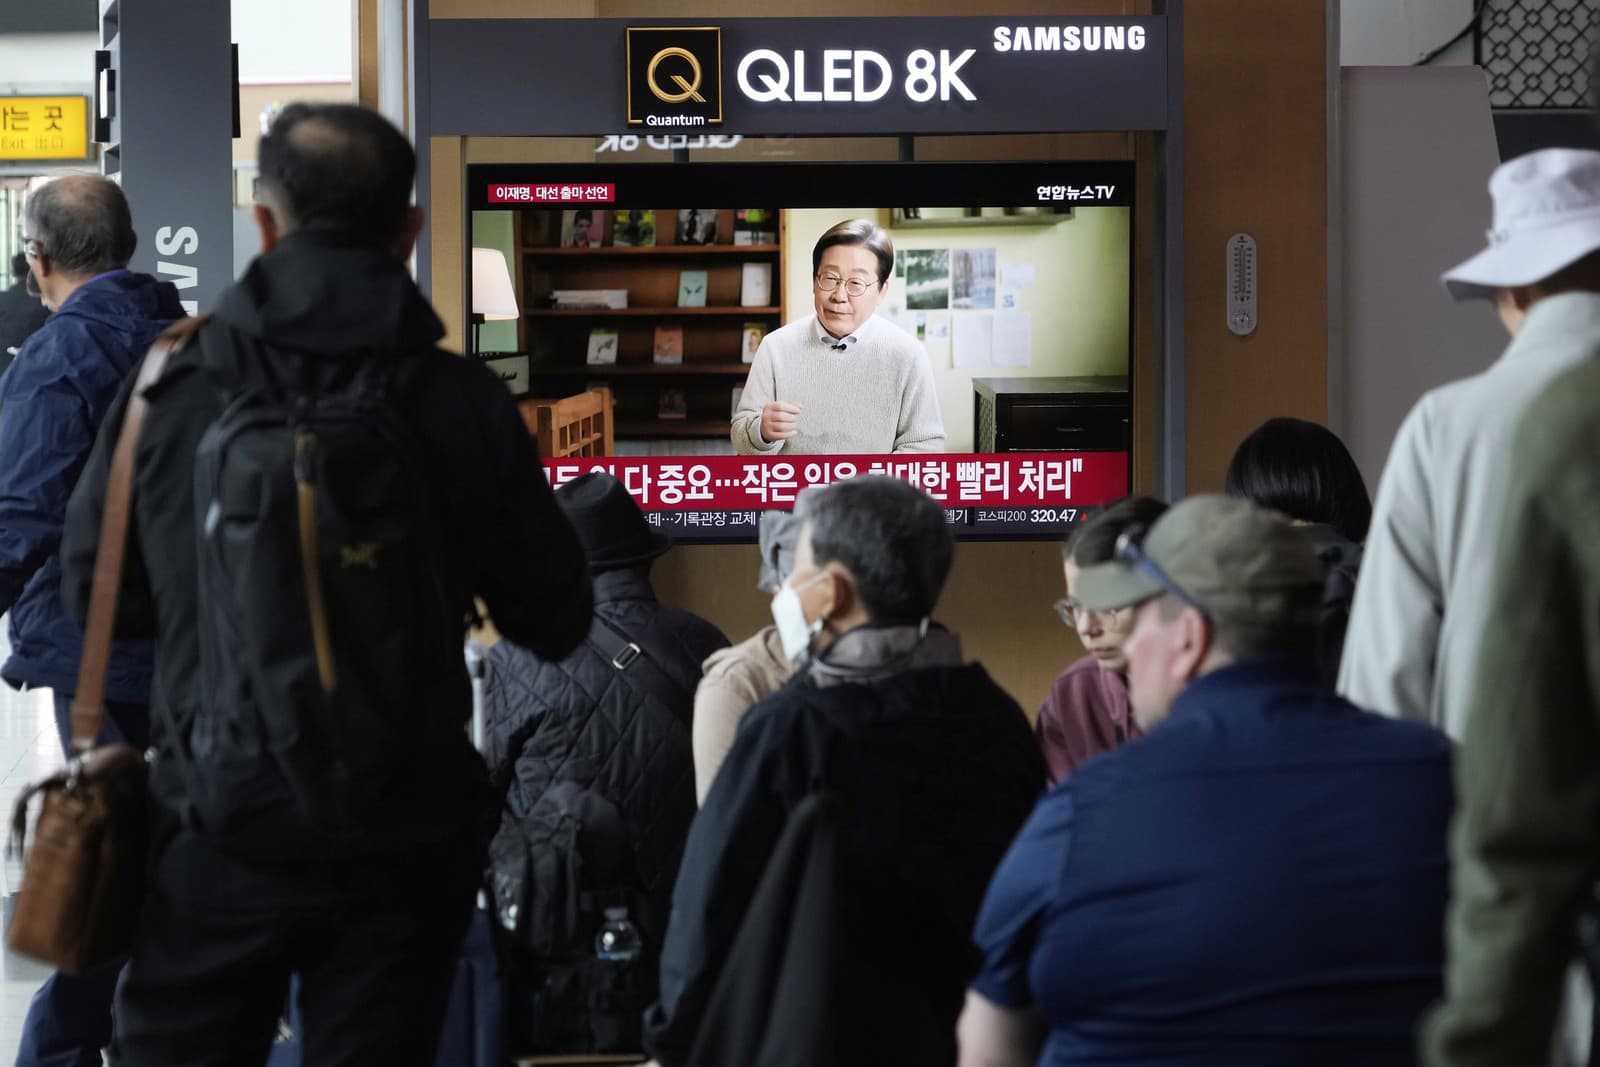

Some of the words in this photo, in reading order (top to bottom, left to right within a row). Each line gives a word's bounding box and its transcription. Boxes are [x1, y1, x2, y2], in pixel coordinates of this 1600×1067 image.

[993, 25, 1146, 51] SAMSUNG
[737, 49, 893, 102] QLED
[905, 49, 977, 102] 8K
[44, 105, 63, 131] 곳
[646, 114, 705, 127] Quantum
[496, 187, 534, 201] 이재명,
[536, 186, 559, 200] 대선
[560, 187, 583, 200] 출마
[585, 186, 608, 199] 선언
[1036, 185, 1116, 200] 연합뉴스TV
[956, 460, 1010, 501] 빨리
[729, 511, 756, 526] 교체
[977, 510, 1026, 523] 코스피200
[1030, 509, 1077, 523] 320.47
